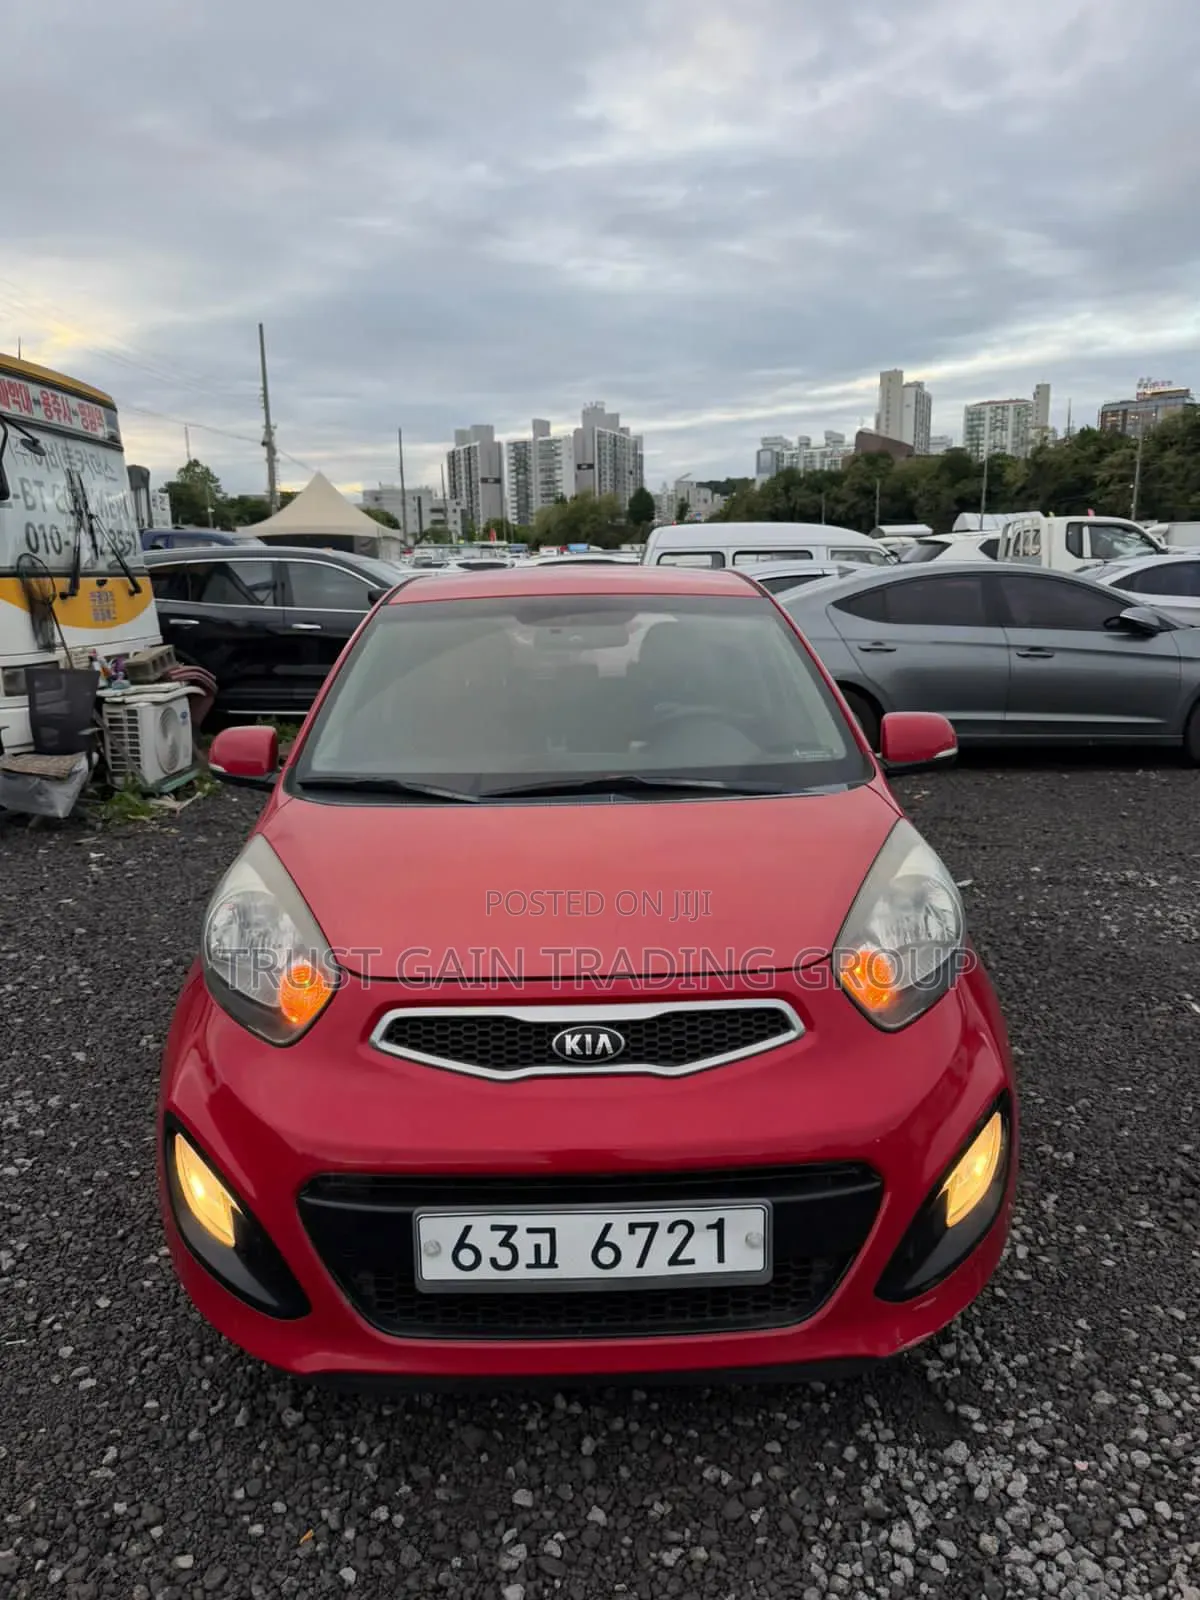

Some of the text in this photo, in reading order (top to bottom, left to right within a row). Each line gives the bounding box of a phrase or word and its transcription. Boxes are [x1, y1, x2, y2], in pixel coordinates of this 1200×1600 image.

[564, 1033, 614, 1056] KIA
[451, 1217, 726, 1272] 63고 6721
